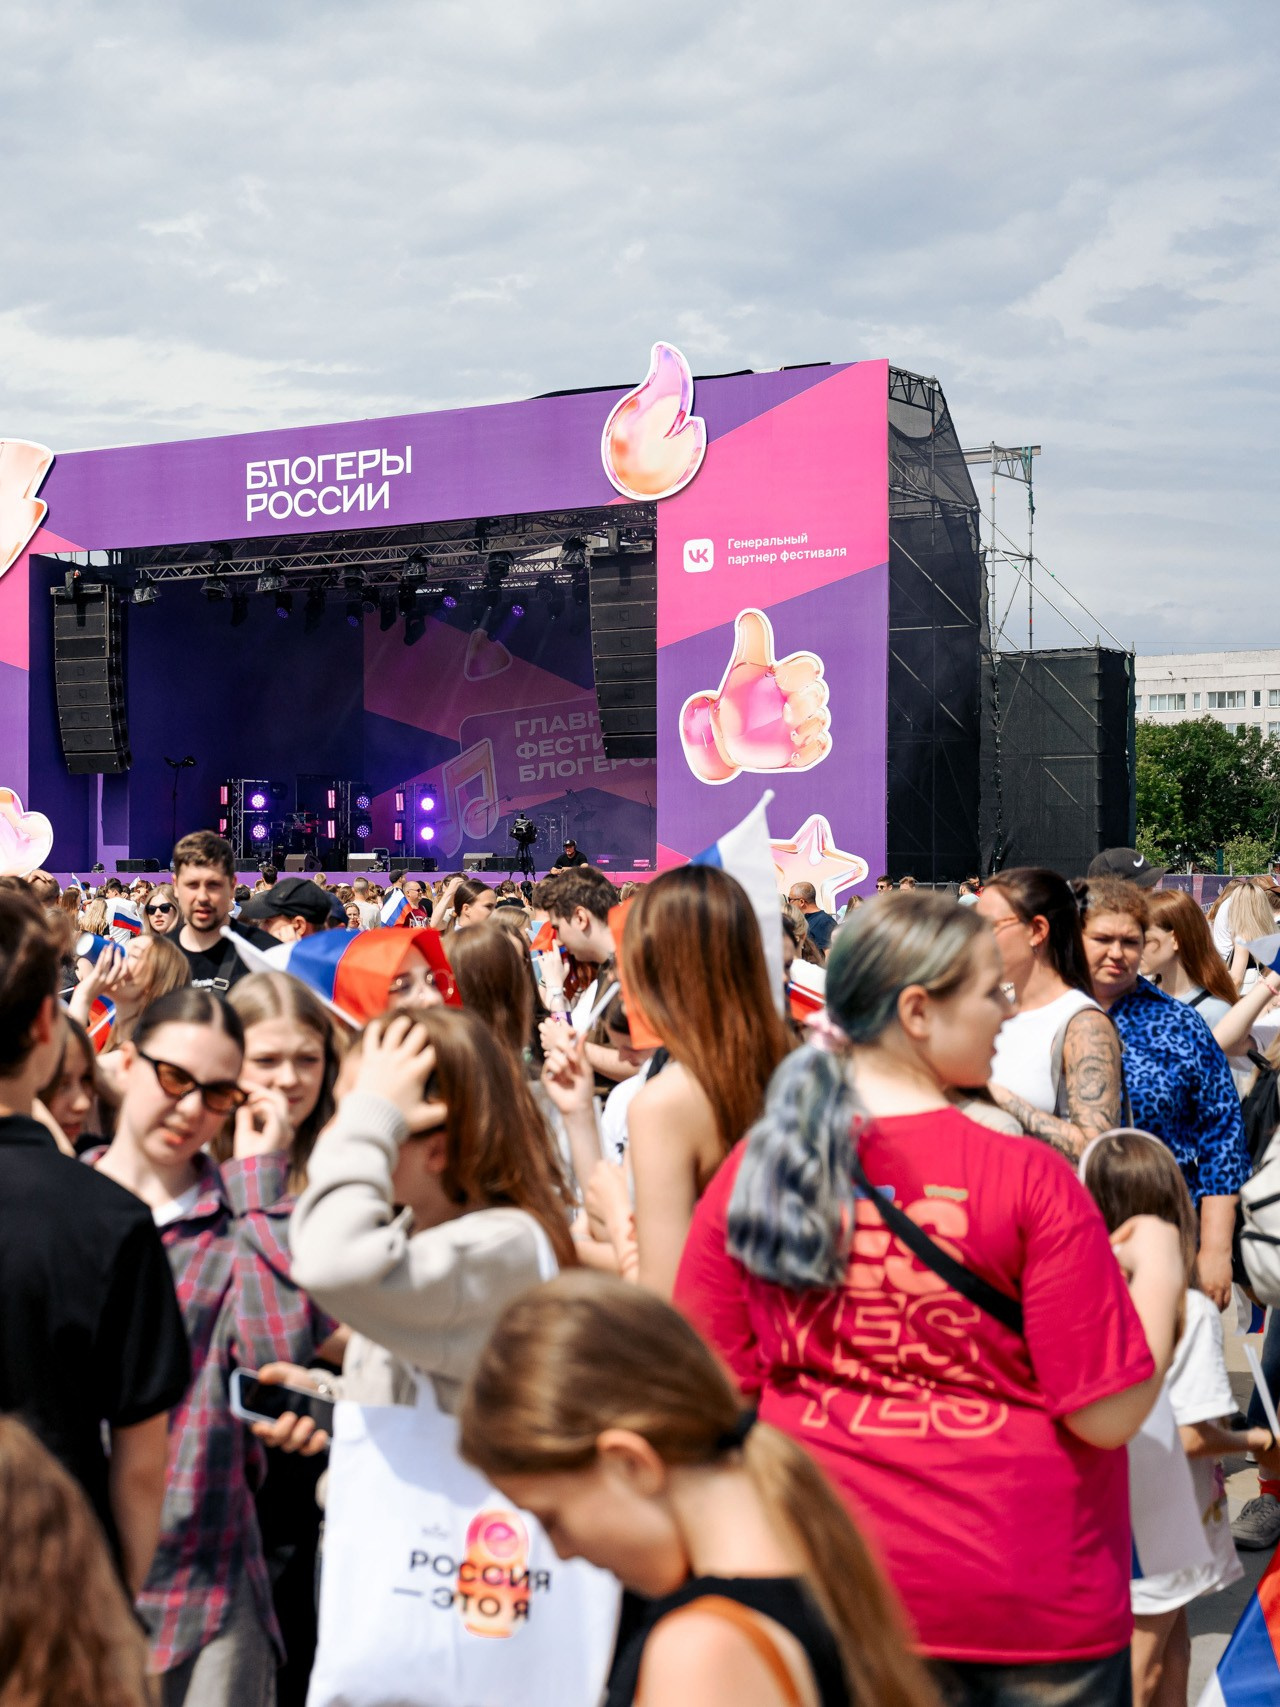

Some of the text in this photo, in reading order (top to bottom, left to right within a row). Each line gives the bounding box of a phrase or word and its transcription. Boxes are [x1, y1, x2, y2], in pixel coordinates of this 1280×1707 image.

[246, 445, 412, 490] БЛОГЕРЫ
[246, 481, 390, 522] РОССИИ
[688, 548, 709, 564] VK
[727, 532, 809, 550] Генеральный
[727, 547, 847, 566] партнер фестиваля
[409, 1550, 551, 1592] РОССИЯ
[431, 1587, 501, 1616] ЭТО
[512, 1600, 531, 1623] Я
